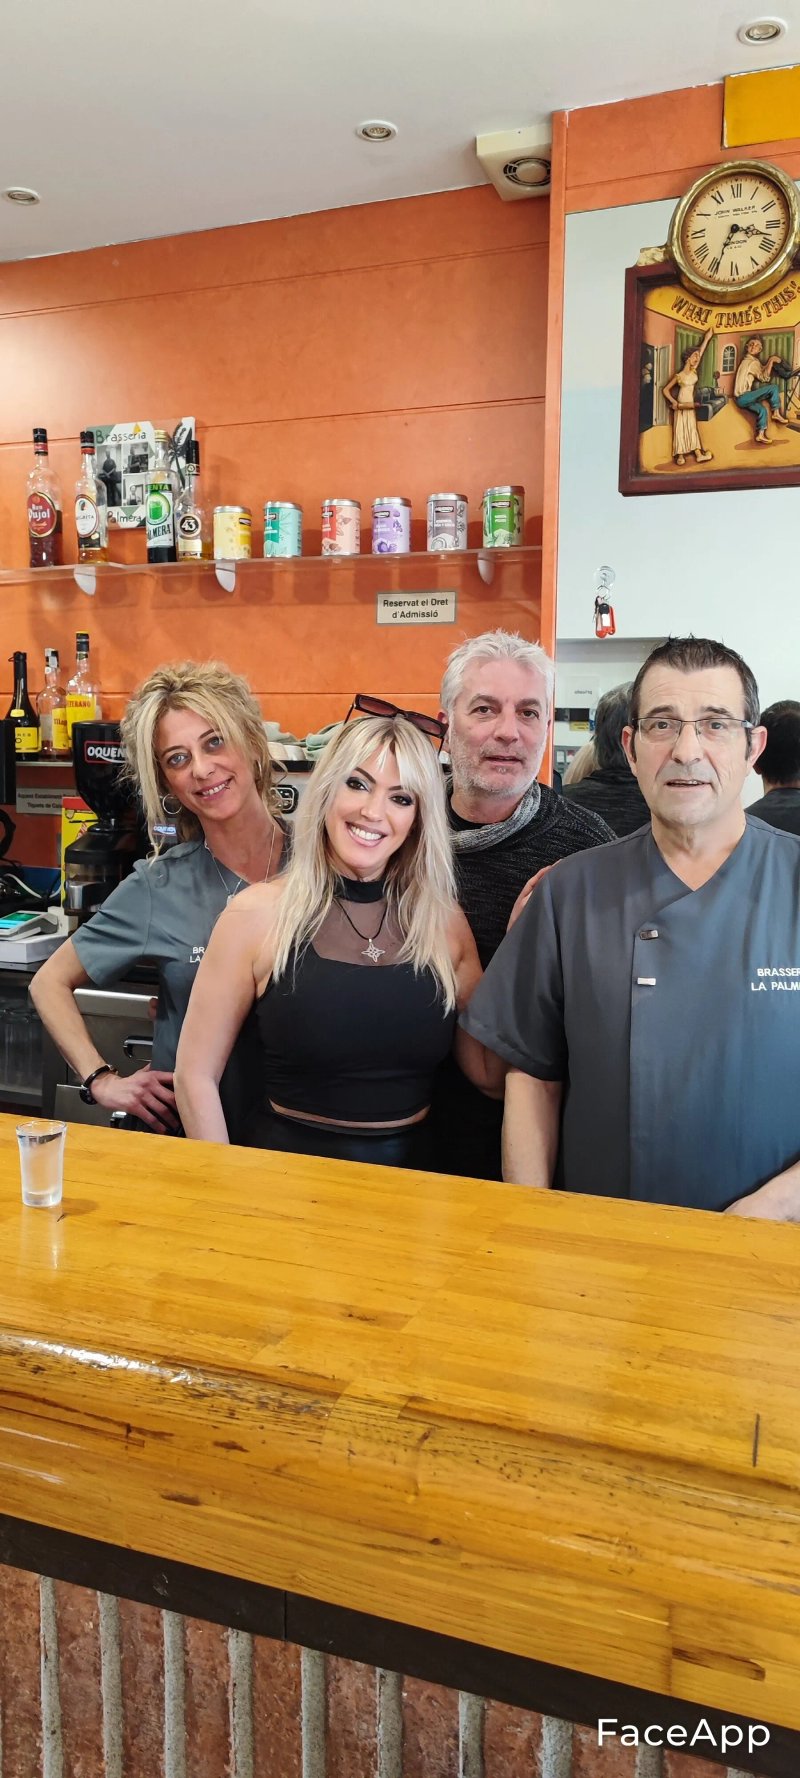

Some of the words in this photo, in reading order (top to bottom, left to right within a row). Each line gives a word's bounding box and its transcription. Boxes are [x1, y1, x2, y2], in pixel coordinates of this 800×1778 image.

[733, 205, 756, 213] WALKER
[671, 296, 713, 326] WHAT
[714, 305, 762, 328] TIME'S
[95, 429, 147, 444] Brasseria
[28, 508, 51, 522] Pujol
[107, 510, 142, 524] Palmera
[181, 519, 197, 531] 43
[383, 599, 419, 607] Reservat
[421, 598, 429, 606] el
[431, 598, 449, 606] Dret
[392, 610, 439, 619] d'Admissió
[87, 746, 125, 760] OQUEN
[750, 982, 767, 991] LA
[771, 981, 800, 991] PALM
